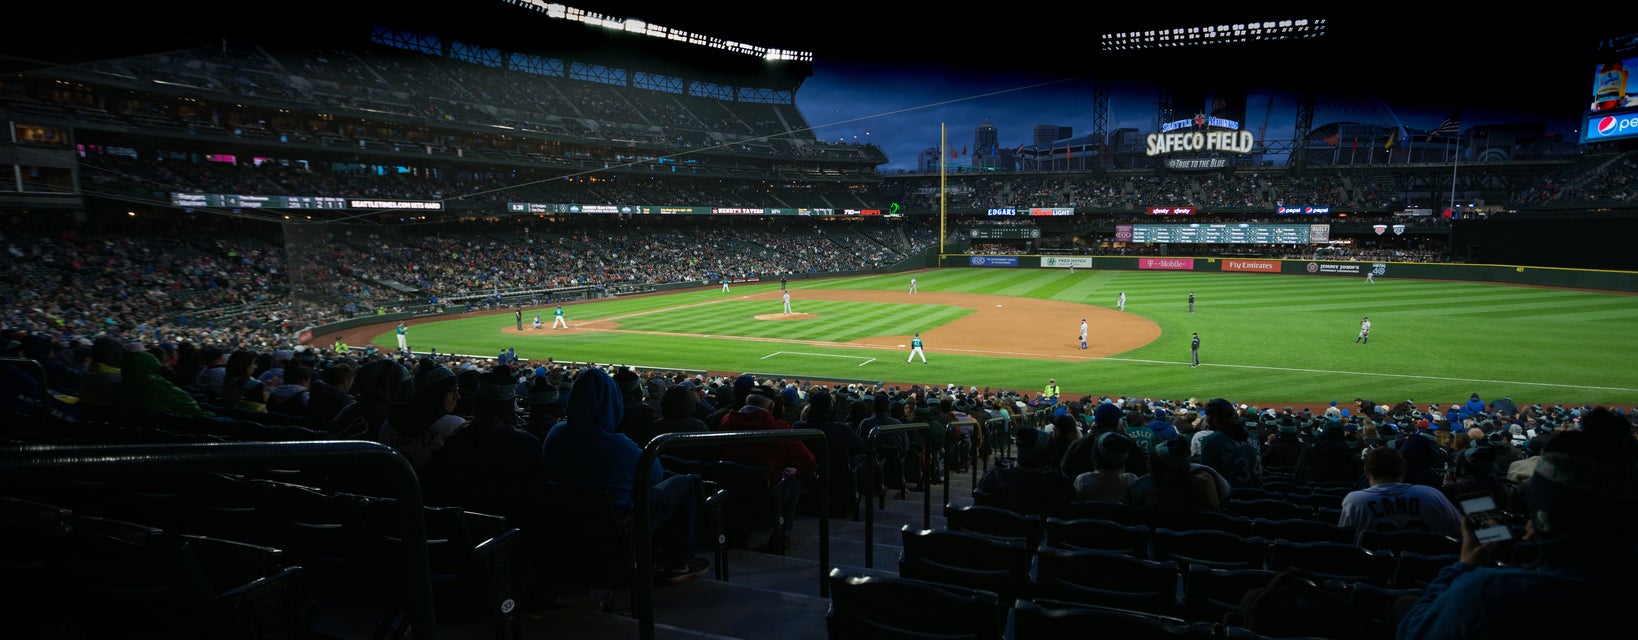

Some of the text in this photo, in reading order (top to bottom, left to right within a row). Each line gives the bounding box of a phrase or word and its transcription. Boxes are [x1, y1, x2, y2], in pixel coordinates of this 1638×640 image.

[1146, 131, 1254, 156] SAFECO FIELD
[1176, 158, 1225, 168] TRUE TO THE BLUE
[1152, 207, 1191, 215] xfinity xfinity
[1229, 261, 1273, 269] Fly Emirates
[1367, 497, 1420, 518] CANO
